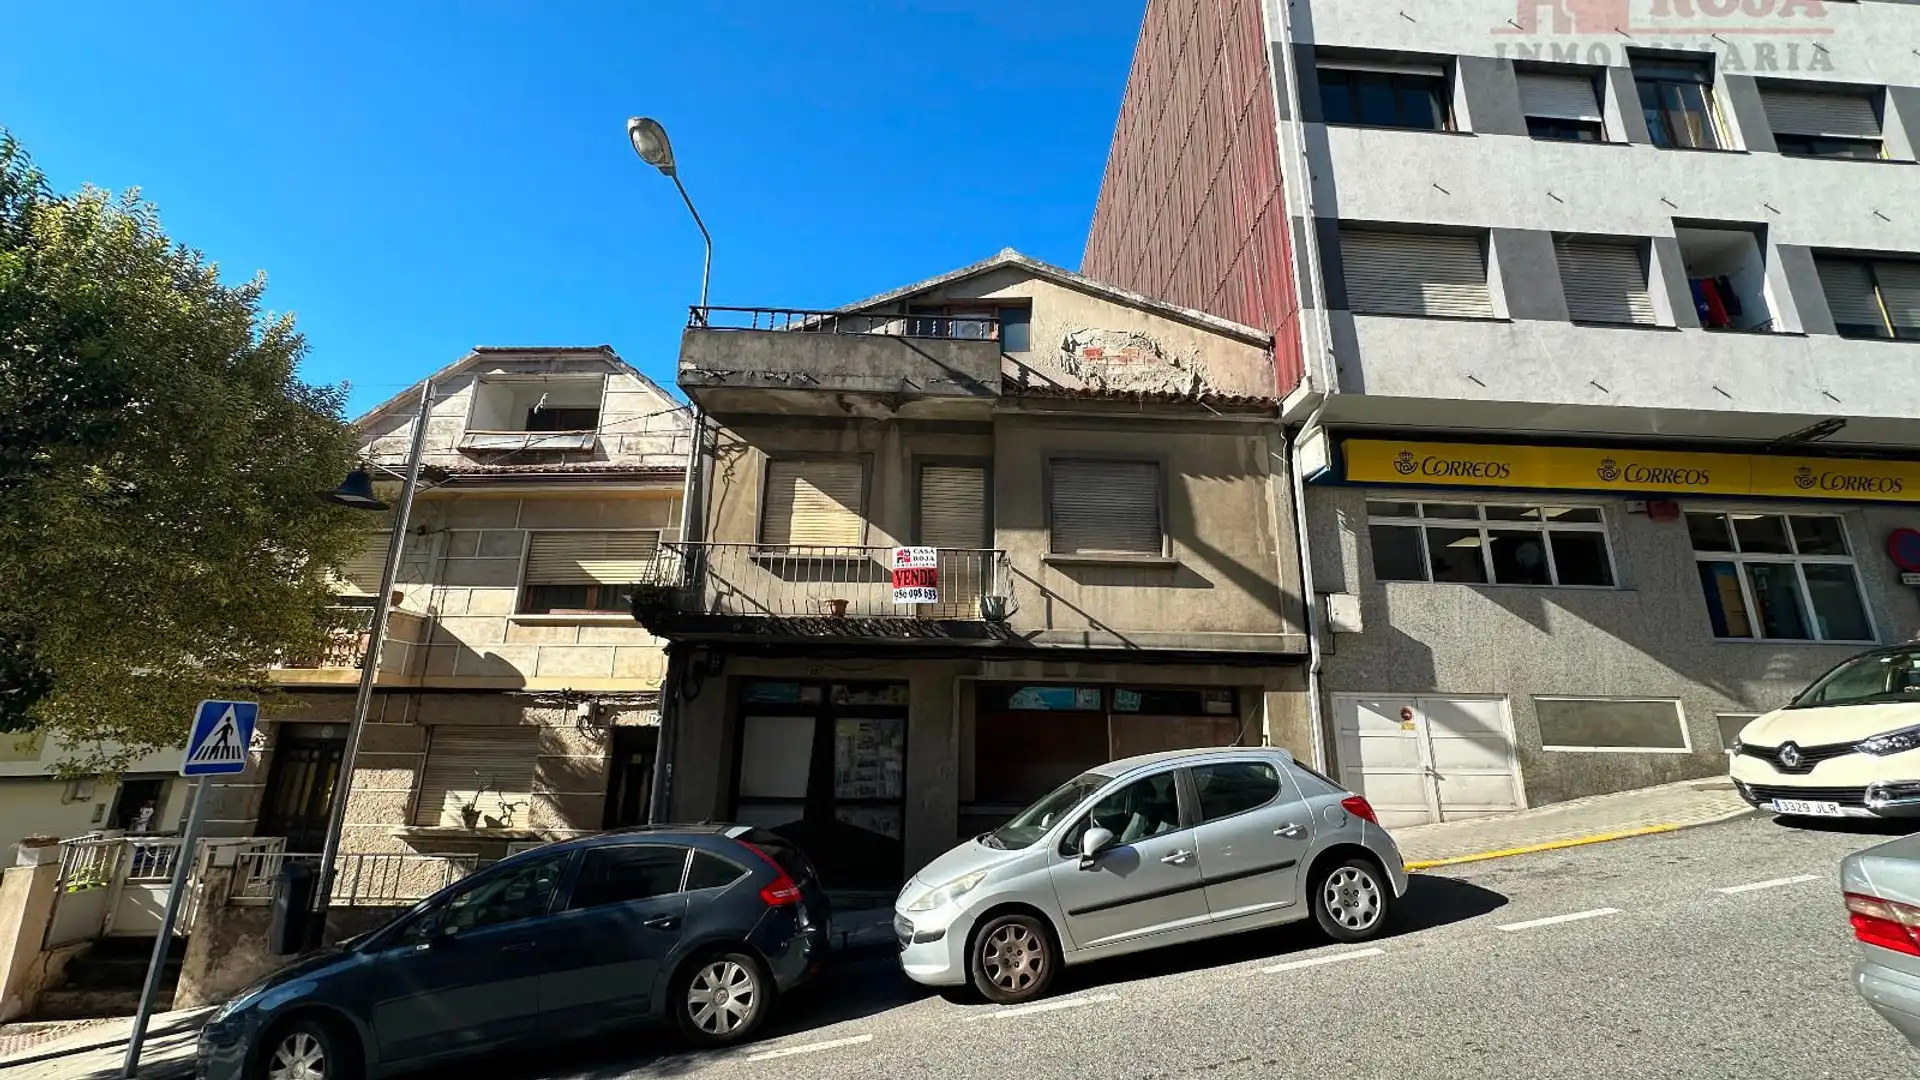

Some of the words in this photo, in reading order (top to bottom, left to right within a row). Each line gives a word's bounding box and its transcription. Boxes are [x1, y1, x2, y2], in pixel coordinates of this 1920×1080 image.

[1421, 456, 1511, 479] CORREOS
[1624, 463, 1711, 485] CORREOS
[1820, 471, 1904, 493] CORREOS
[895, 569, 935, 586] VENDE
[923, 588, 937, 600] 633
[1781, 801, 1811, 813] 3329
[1815, 803, 1839, 814] JLR
